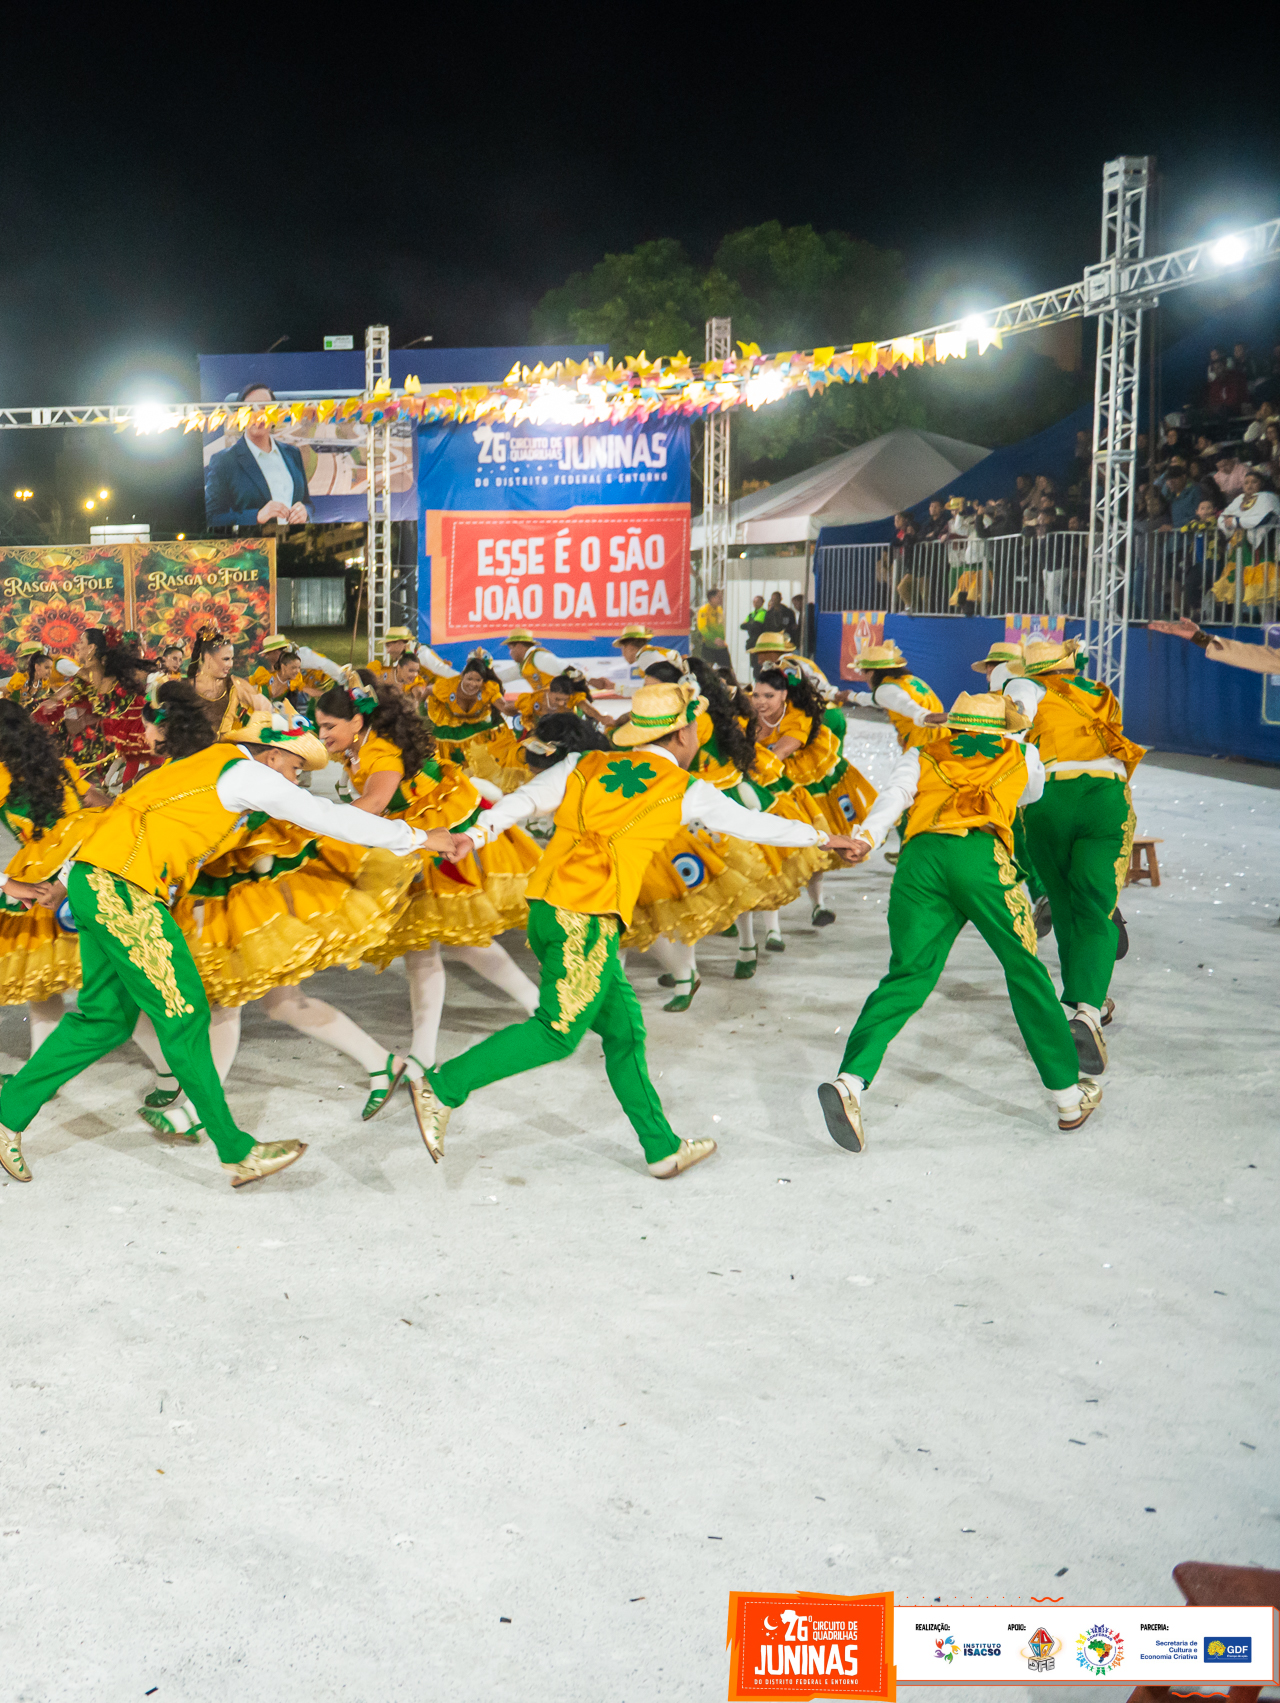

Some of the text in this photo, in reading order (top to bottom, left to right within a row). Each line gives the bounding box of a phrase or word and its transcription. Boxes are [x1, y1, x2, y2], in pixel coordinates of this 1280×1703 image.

[509, 436, 562, 449] CIRCUITO DE
[558, 432, 667, 470] JUNINAS
[509, 448, 562, 462] QUADRILHAS
[475, 471, 668, 488] DO DISTRITO FEDERAL E ENTORNO
[477, 526, 665, 576] ESSE É O SÃO
[3, 577, 59, 598] RASGA
[73, 574, 114, 595] FOLE
[147, 570, 203, 592] RASGA
[217, 567, 259, 587] FOLE
[468, 577, 671, 622] JOÃO DA LIGA
